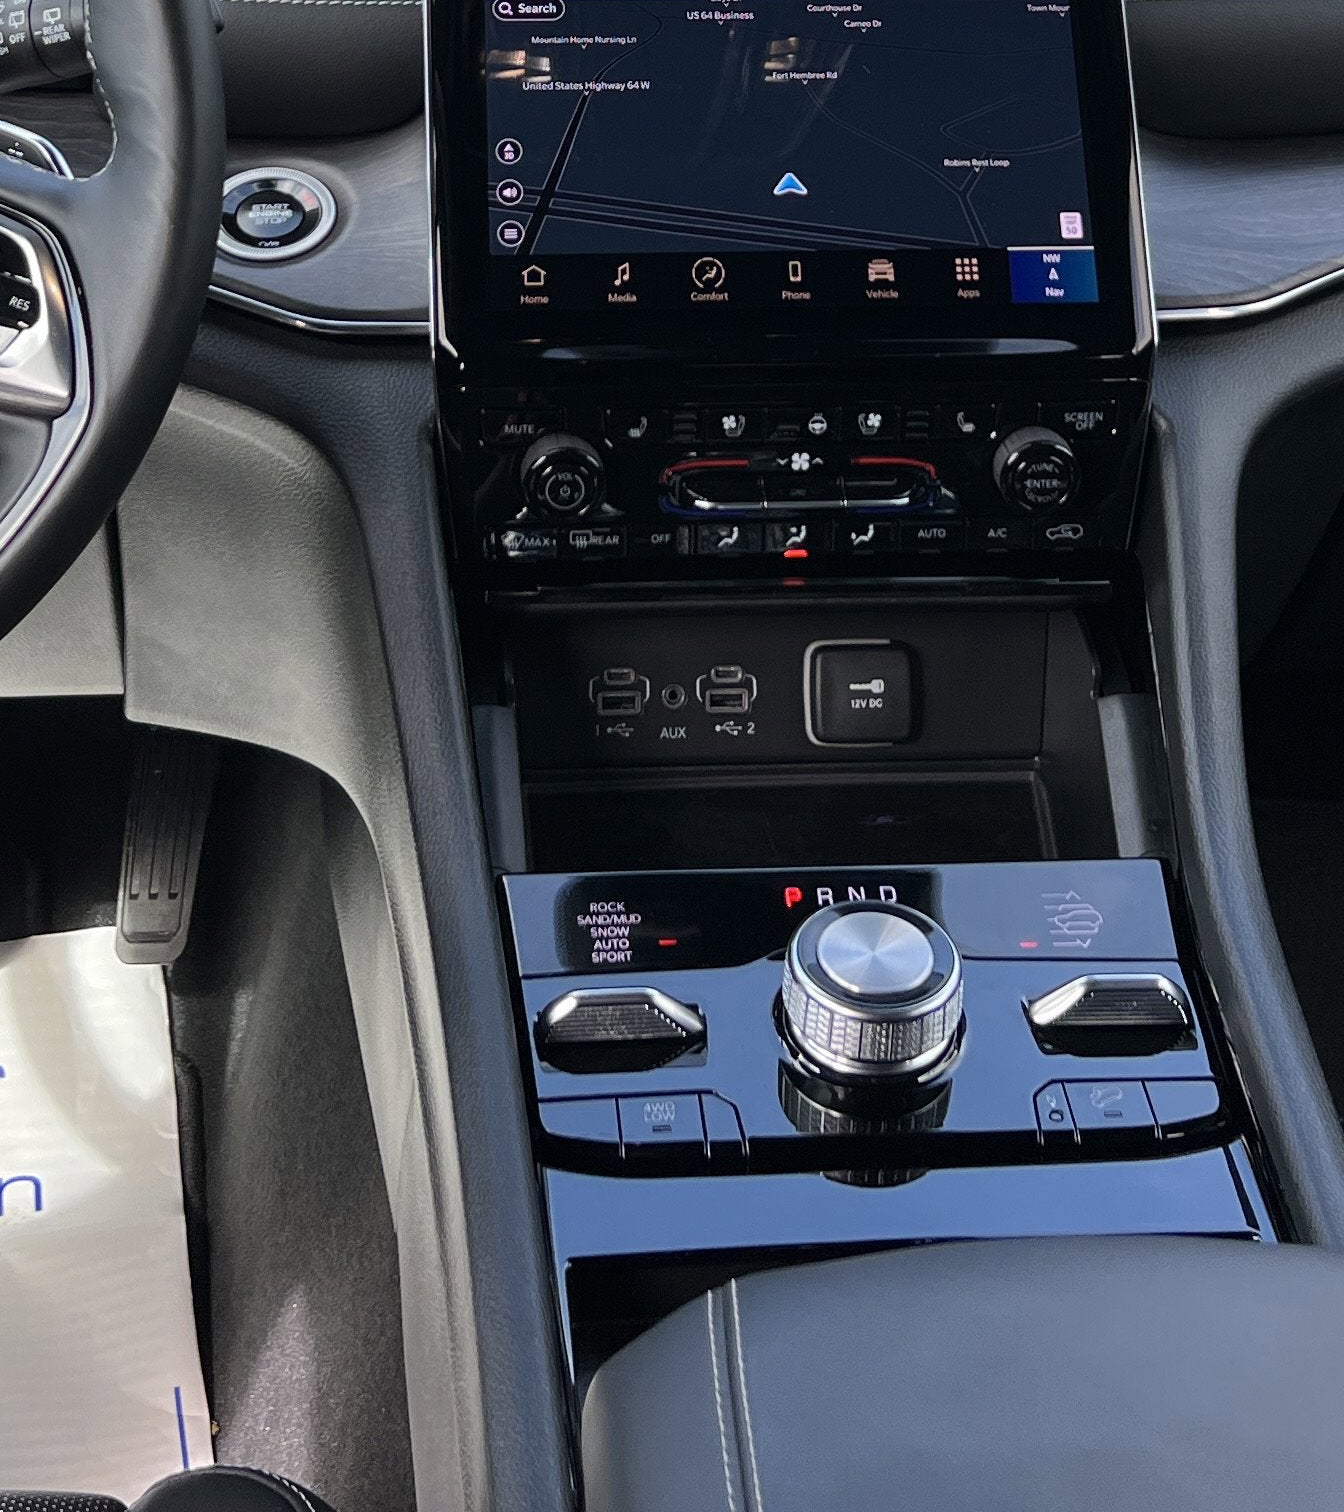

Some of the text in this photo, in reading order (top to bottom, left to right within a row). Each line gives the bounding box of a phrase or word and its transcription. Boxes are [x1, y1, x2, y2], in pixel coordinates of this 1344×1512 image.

[517, 3, 557, 14] Search
[806, 4, 863, 13] Courthouse Dr
[1027, 4, 1047, 13] Town
[686, 10, 755, 21] US 64 Business
[42, 23, 66, 36] REAR
[844, 19, 882, 29] Cameo Dr
[9, 32, 26, 45] OFF
[42, 32, 71, 46] WIPER
[531, 36, 637, 46] Mountain Home Nursing Ln
[772, 71, 838, 80] Fort Hembree Rd
[522, 81, 650, 92] United States Highway 64 W
[943, 158, 1009, 169] Robins Rest Loop
[252, 203, 290, 211] START
[255, 217, 288, 225] STOP
[1065, 226, 1078, 236] 50
[1042, 253, 1061, 263] NW
[608, 292, 637, 303] Media
[690, 291, 729, 302] Comfort
[781, 289, 811, 300] Phone
[865, 289, 899, 300] Vehicle
[957, 288, 980, 299] Apps
[1045, 287, 1065, 298] Nav
[8, 295, 31, 312] RES
[520, 294, 549, 305] Home
[1063, 411, 1104, 423] SCREEN
[504, 423, 535, 435] MUTE
[1075, 420, 1096, 431] OFF
[1026, 478, 1058, 489] ENTER
[651, 533, 671, 544] OFF
[917, 527, 947, 539] AUTO
[987, 527, 1007, 539] A/C
[524, 537, 551, 548] MAX
[591, 535, 620, 546] REAR
[851, 698, 883, 709] 12V DC
[660, 727, 687, 739] AUX
[747, 723, 755, 735] 2
[784, 886, 897, 908] P R N D
[589, 901, 626, 913] ROCK
[576, 913, 642, 926] SAND/MUD
[590, 926, 630, 938] SNOW
[593, 938, 630, 950] AUTO
[591, 950, 633, 964] SPORT
[643, 1101, 675, 1113] 4WD
[643, 1111, 676, 1123] LOW
